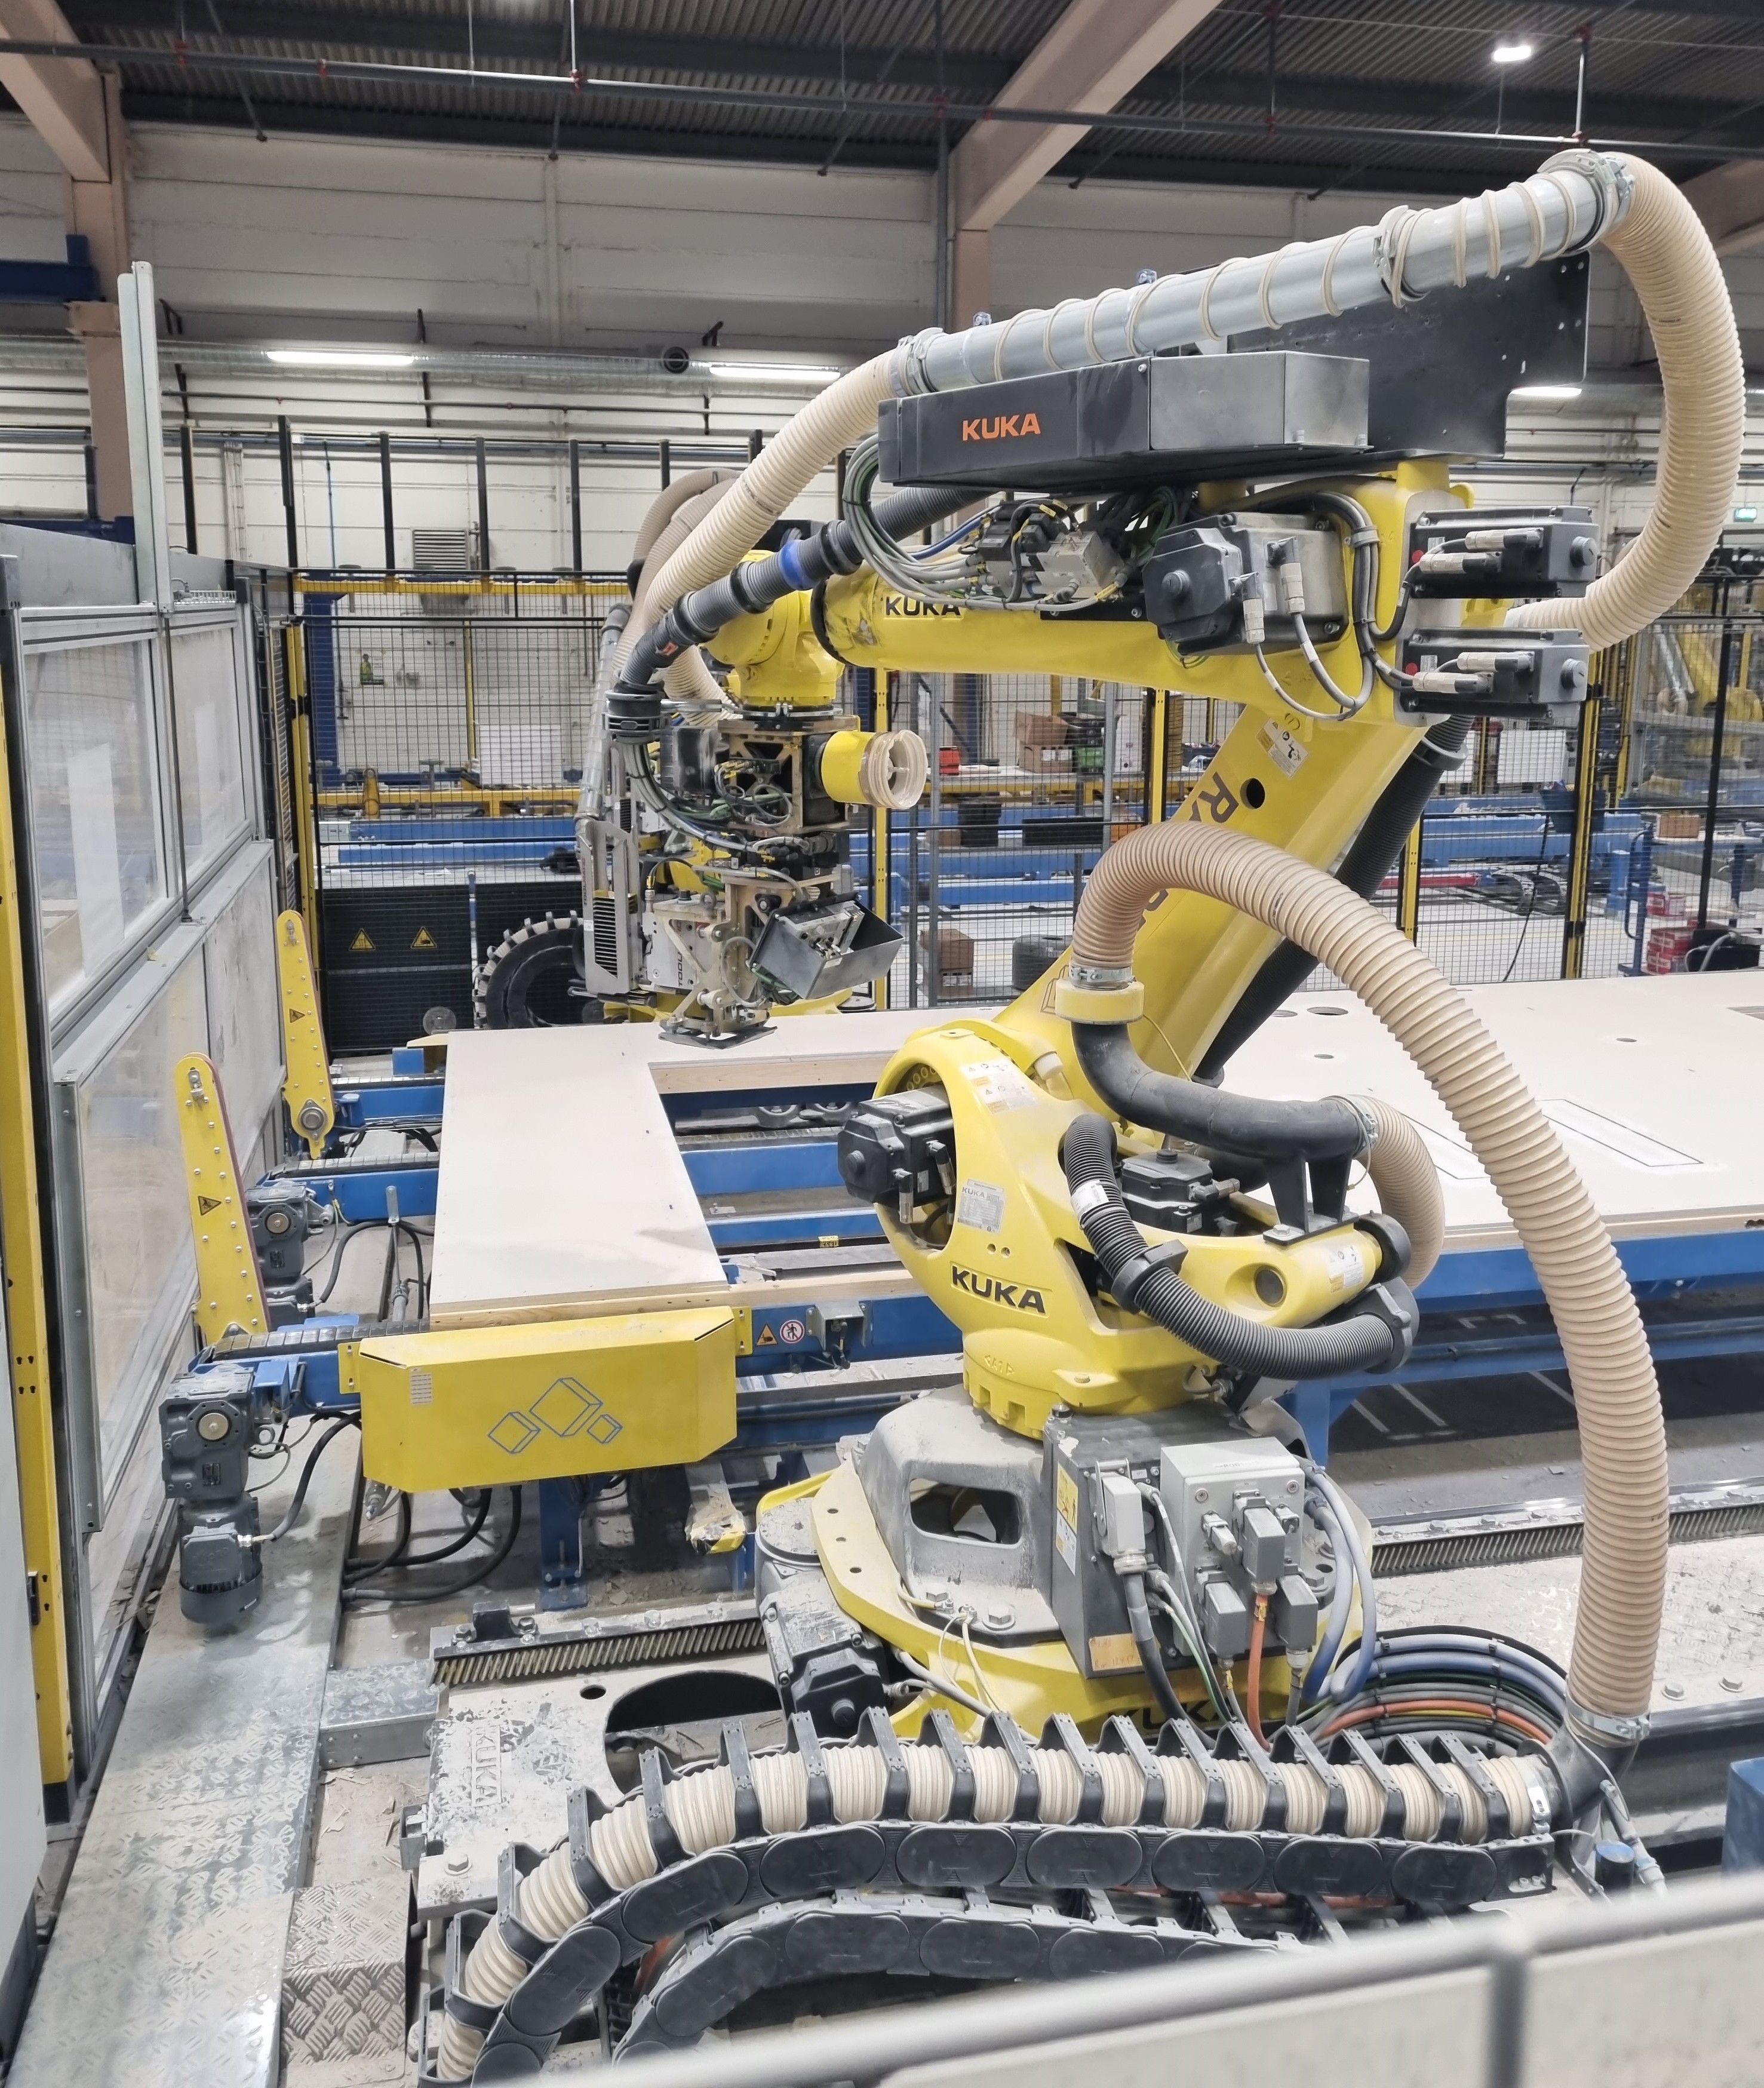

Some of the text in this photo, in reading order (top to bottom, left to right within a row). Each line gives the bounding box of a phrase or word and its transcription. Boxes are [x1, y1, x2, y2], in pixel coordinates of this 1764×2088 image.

[962, 413, 1041, 441] KUKA
[886, 596, 961, 616] KUKA
[962, 1187, 985, 1199] KUKA
[952, 1265, 1046, 1313] KUKA
[475, 1727, 497, 1805] KUKA
